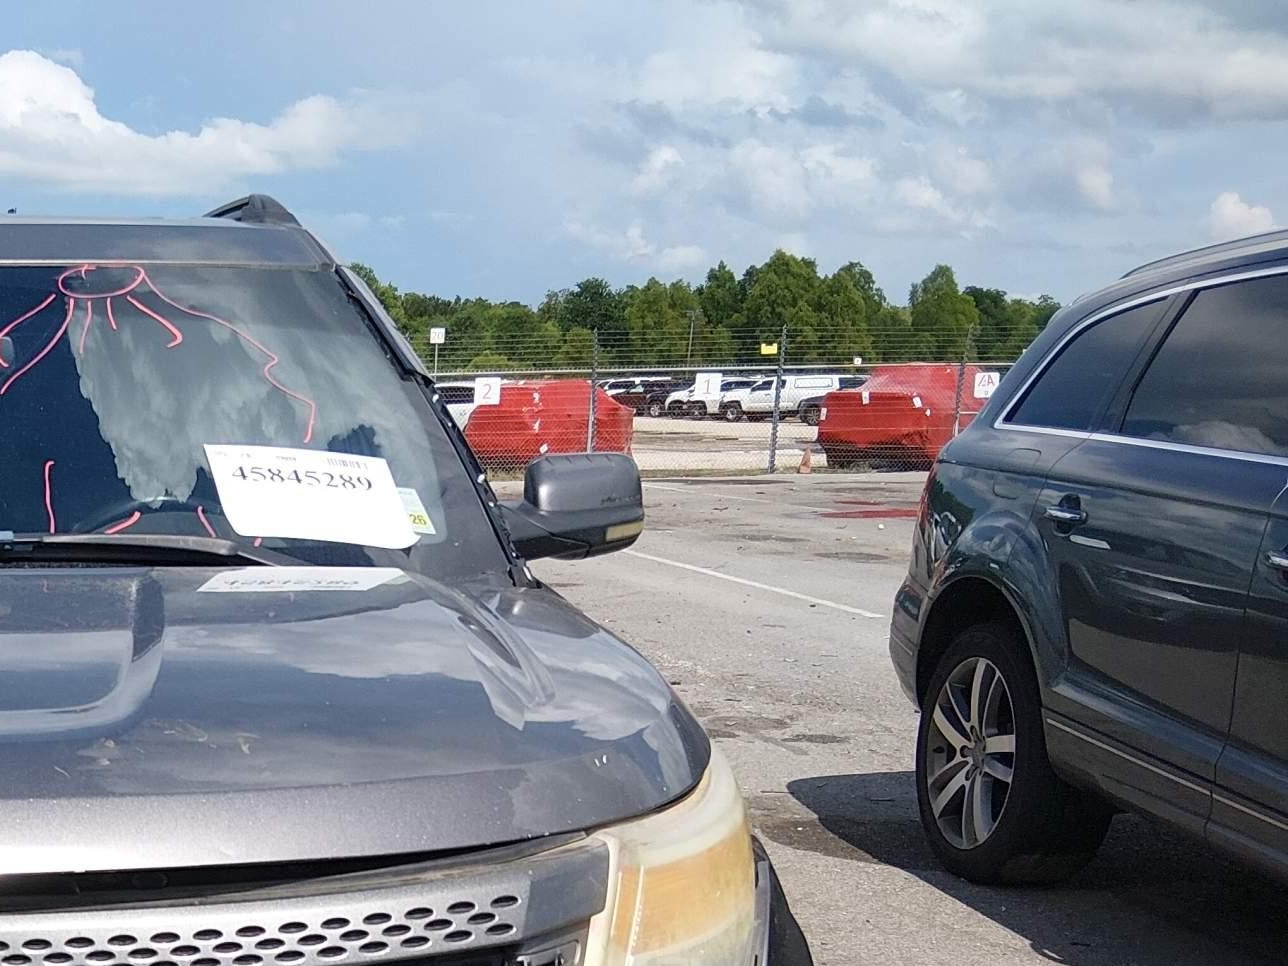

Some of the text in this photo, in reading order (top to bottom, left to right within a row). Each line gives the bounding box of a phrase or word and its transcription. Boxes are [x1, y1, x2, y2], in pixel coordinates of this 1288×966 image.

[482, 383, 492, 400] 2
[703, 378, 712, 395] 1
[231, 465, 373, 492] 45845289
